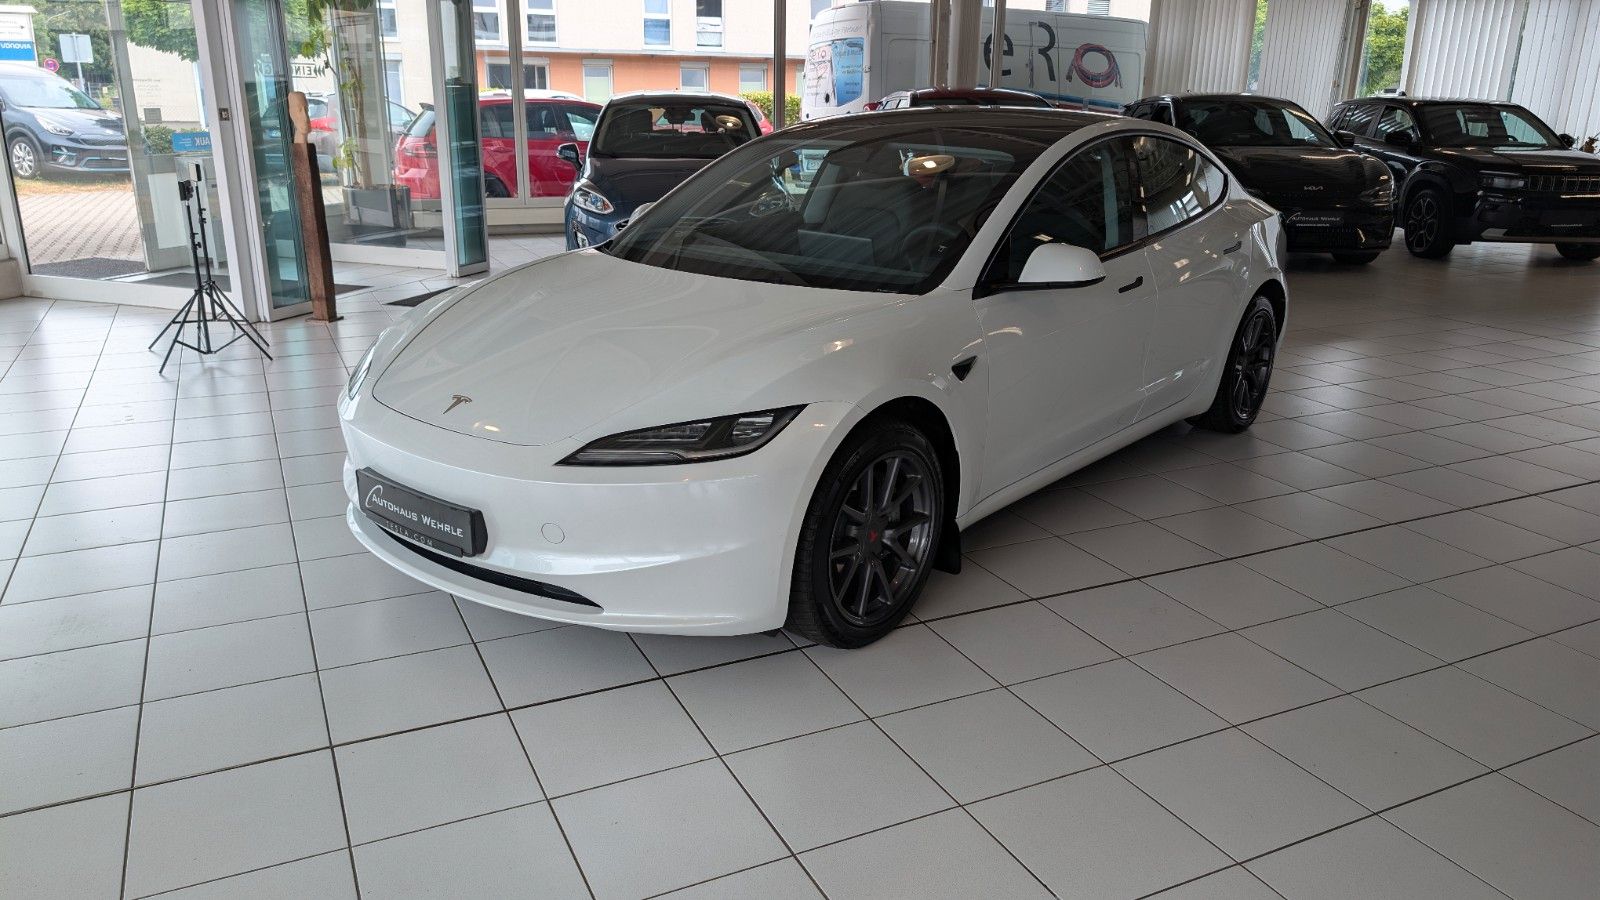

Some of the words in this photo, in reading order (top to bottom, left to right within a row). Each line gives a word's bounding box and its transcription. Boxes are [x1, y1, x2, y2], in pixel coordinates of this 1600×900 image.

[371, 493, 418, 522] AUTOHAUS
[421, 514, 464, 538] WEHRLE
[385, 520, 434, 547] TESLA.COM
